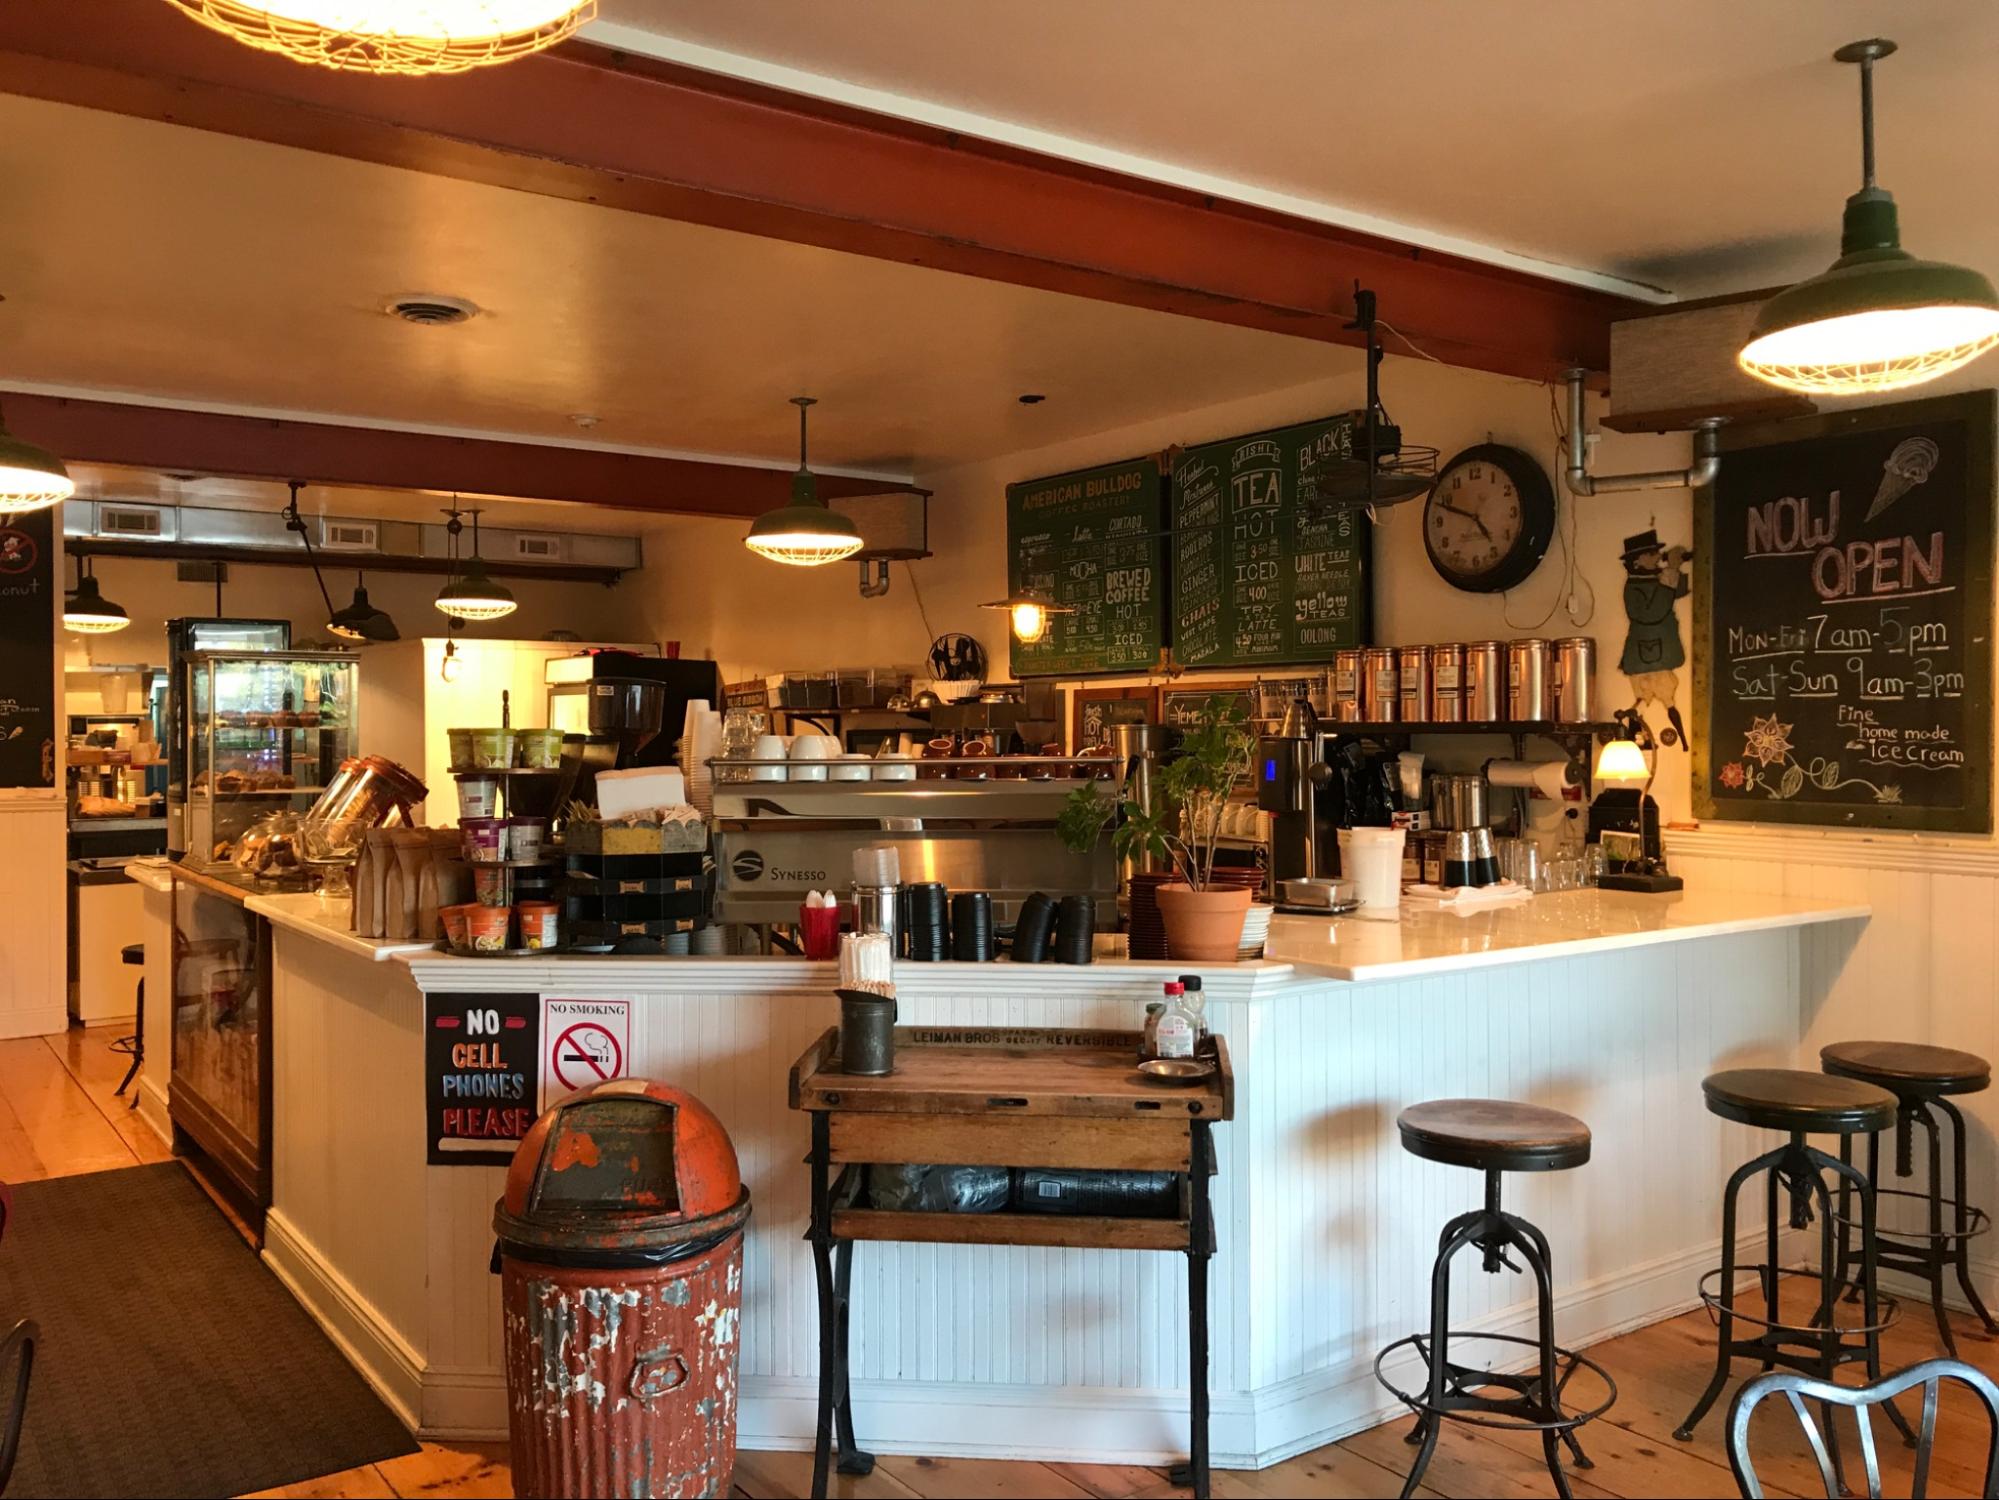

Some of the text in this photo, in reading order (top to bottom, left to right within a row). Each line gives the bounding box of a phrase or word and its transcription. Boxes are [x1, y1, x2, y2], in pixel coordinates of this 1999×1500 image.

[1300, 428, 1339, 471] BLACK
[1469, 467, 1481, 480] 12
[1490, 471, 1495, 484] 1
[1022, 472, 1143, 511] AMERICAN BULLDOG
[1233, 472, 1280, 508] TEA
[1503, 484, 1511, 497] 2
[1509, 506, 1518, 519] 3
[1746, 489, 1840, 553] NOW
[1234, 508, 1280, 540] HOT
[1436, 516, 1443, 528] 9
[1180, 531, 1213, 563] ROOIBOS
[1441, 537, 1449, 549] 8
[1490, 546, 1498, 558] 5
[1295, 553, 1326, 573] WHITE
[1472, 555, 1480, 567] 6
[1811, 530, 1944, 599] OPEN
[1069, 561, 1098, 580] MOCHA
[1106, 567, 1151, 591] BREWED
[1181, 563, 1215, 594] GINGER
[1234, 561, 1278, 583] ICED
[0, 577, 41, 596] onut
[1105, 587, 1150, 605] COFFEE
[1115, 603, 1142, 619] HOT
[1181, 598, 1220, 628] CHAIS
[1240, 604, 1275, 614] TRY
[1295, 591, 1348, 621] yellow
[1309, 608, 1346, 619] TEAS
[1238, 619, 1277, 632] LATTE
[1114, 632, 1143, 646] ICED
[1300, 627, 1336, 644] OOLONG
[1838, 704, 1875, 722] Fine
[1858, 722, 1950, 740] home made
[771, 867, 826, 881] SYNESSO
[550, 1003, 625, 1016] NO SMOKING
[466, 1008, 500, 1036] NO
[913, 1031, 1000, 1044] LEIMAN BROS
[1046, 1035, 1131, 1047] REVERSIBLE
[451, 1042, 508, 1069] CELL
[442, 1071, 524, 1099] PHONES
[443, 1107, 529, 1138] PLEASE
